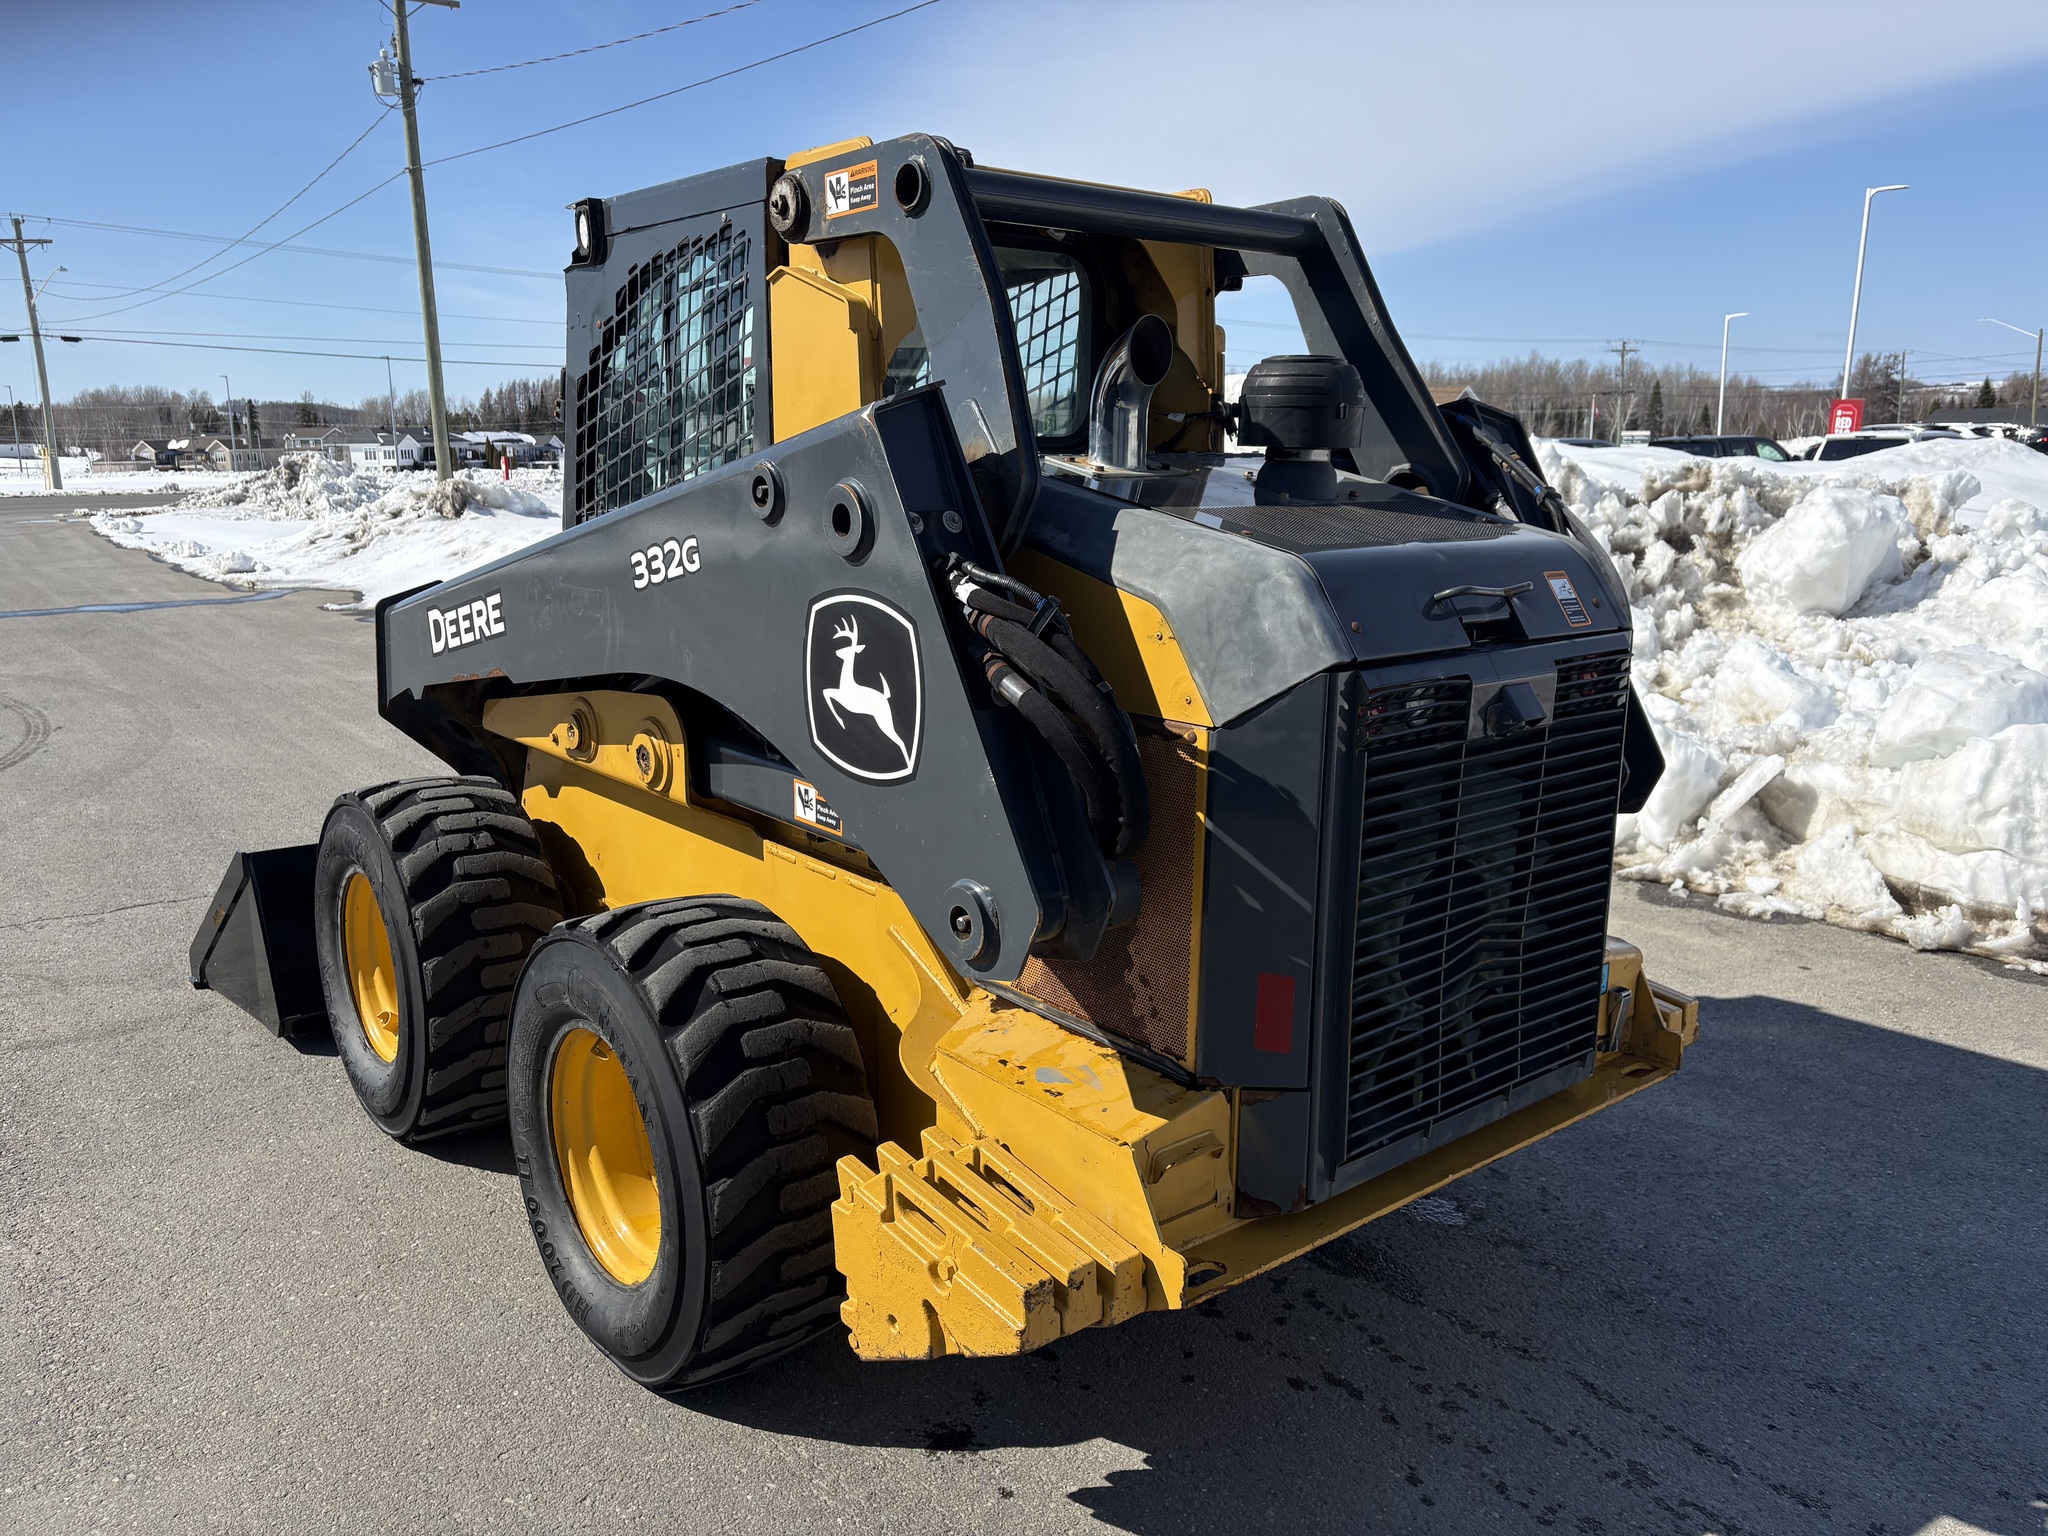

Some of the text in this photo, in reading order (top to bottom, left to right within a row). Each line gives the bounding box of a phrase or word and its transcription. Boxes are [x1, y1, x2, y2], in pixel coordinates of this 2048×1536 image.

[854, 164, 875, 176] WARNING
[850, 183, 875, 194] Pinch Area
[850, 196, 860, 204] Keep
[1835, 416, 1852, 429] RED
[630, 537, 701, 589] 332G
[427, 591, 506, 655] DEERE
